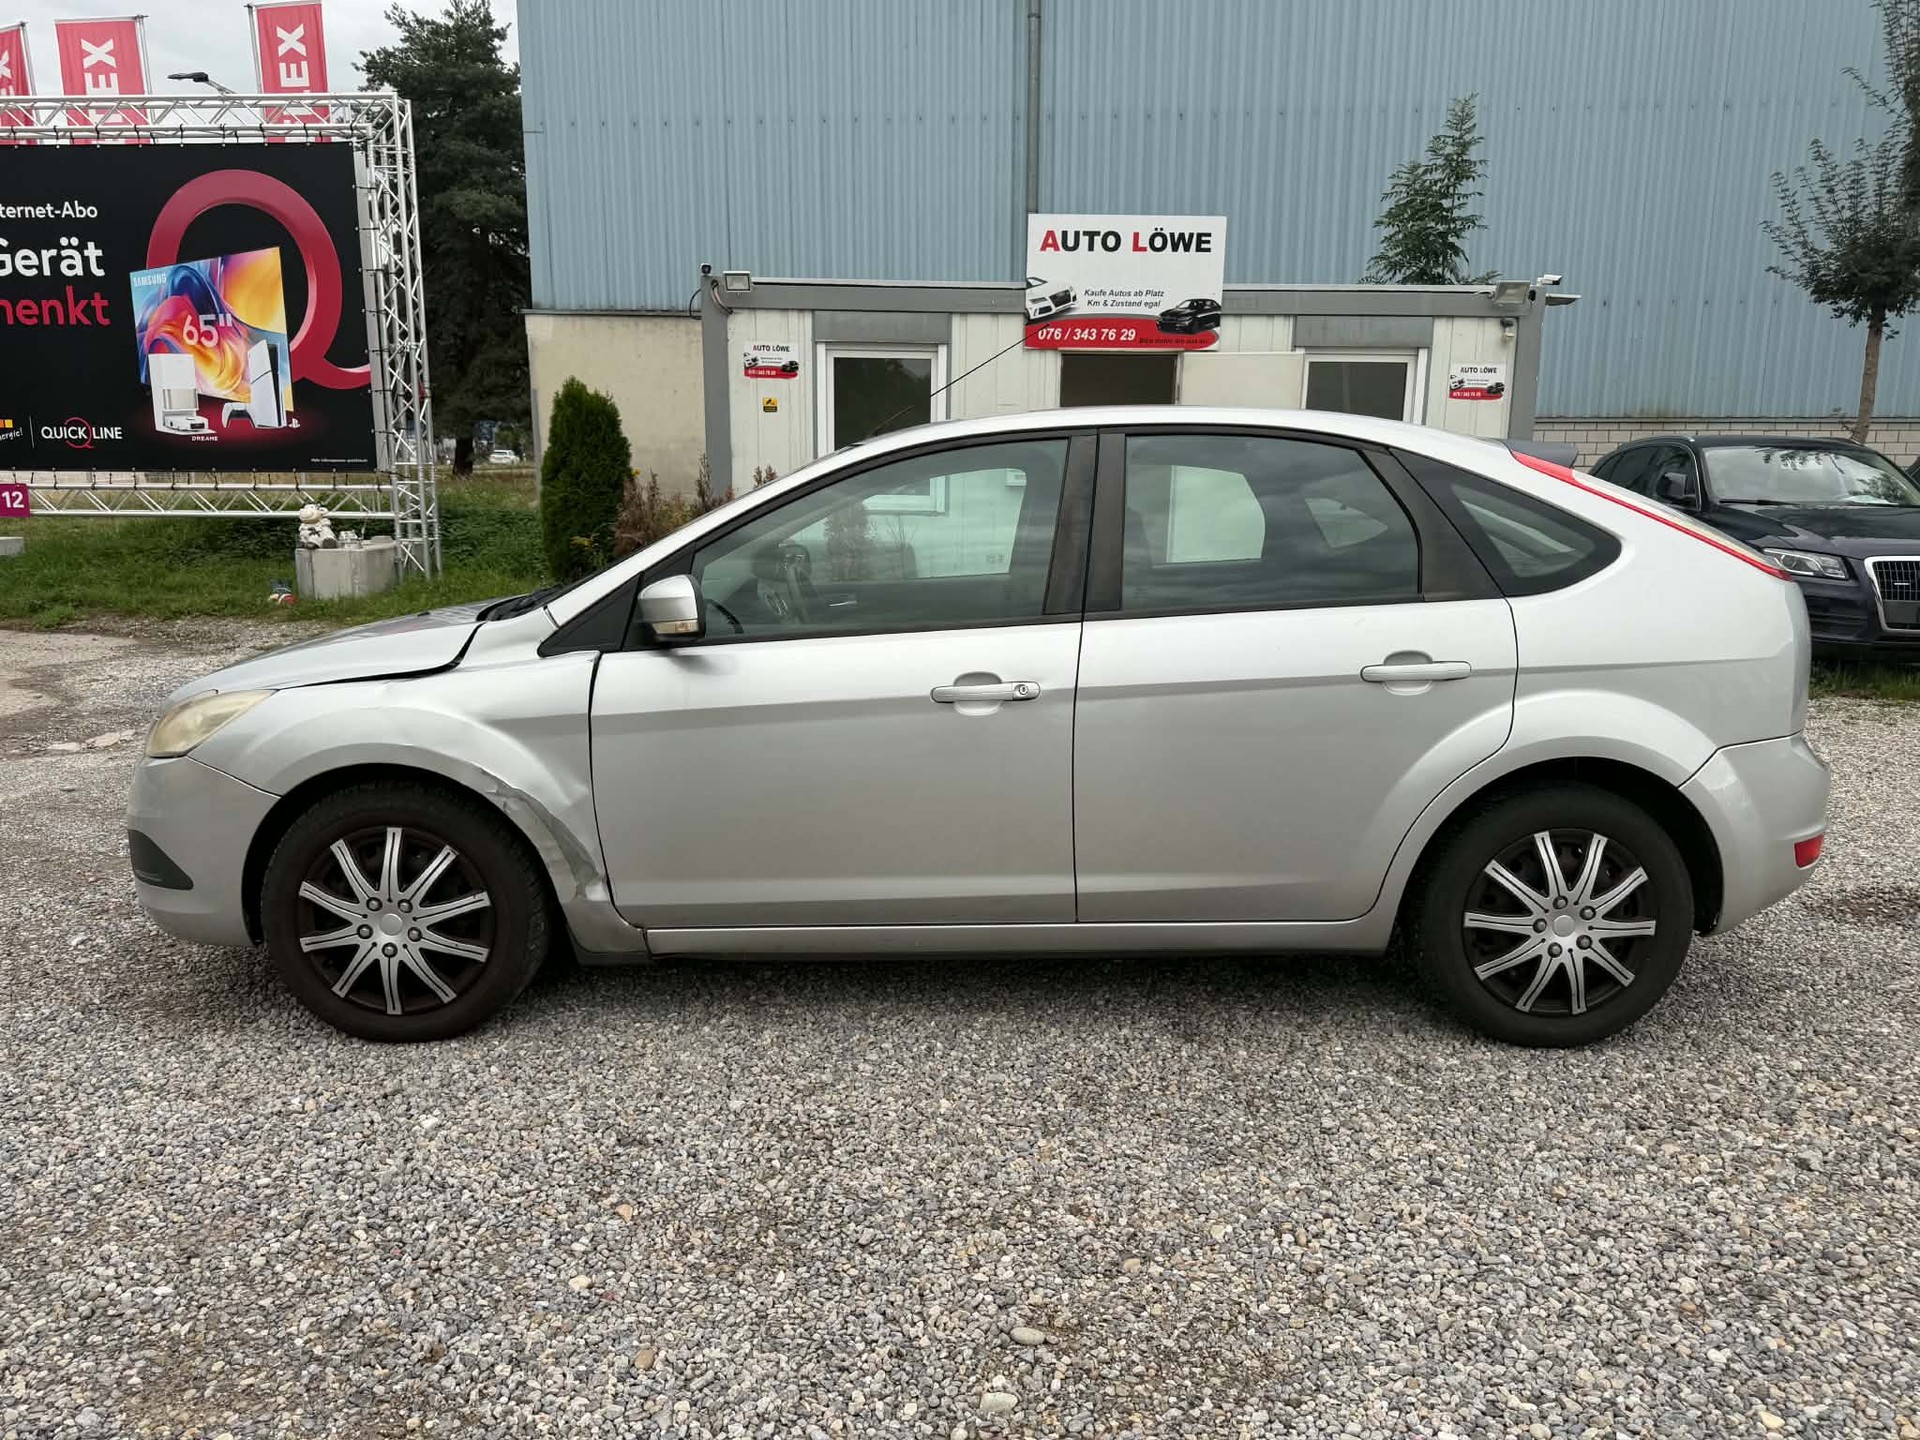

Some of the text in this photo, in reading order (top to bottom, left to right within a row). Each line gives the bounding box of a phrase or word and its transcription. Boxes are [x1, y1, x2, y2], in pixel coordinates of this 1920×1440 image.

[1040, 227, 1212, 252] AUTO LÖWE
[133, 273, 167, 287] SAMSUNG
[1084, 289, 1107, 297] Kaufe
[1108, 289, 1132, 297] Autos
[1144, 289, 1165, 298] Platz
[1144, 300, 1162, 309] egal
[1038, 328, 1136, 341] 076 / 343 76 29
[772, 344, 790, 352] LÖWE
[1480, 366, 1497, 374] LÖWE
[2, 491, 25, 509] 12
